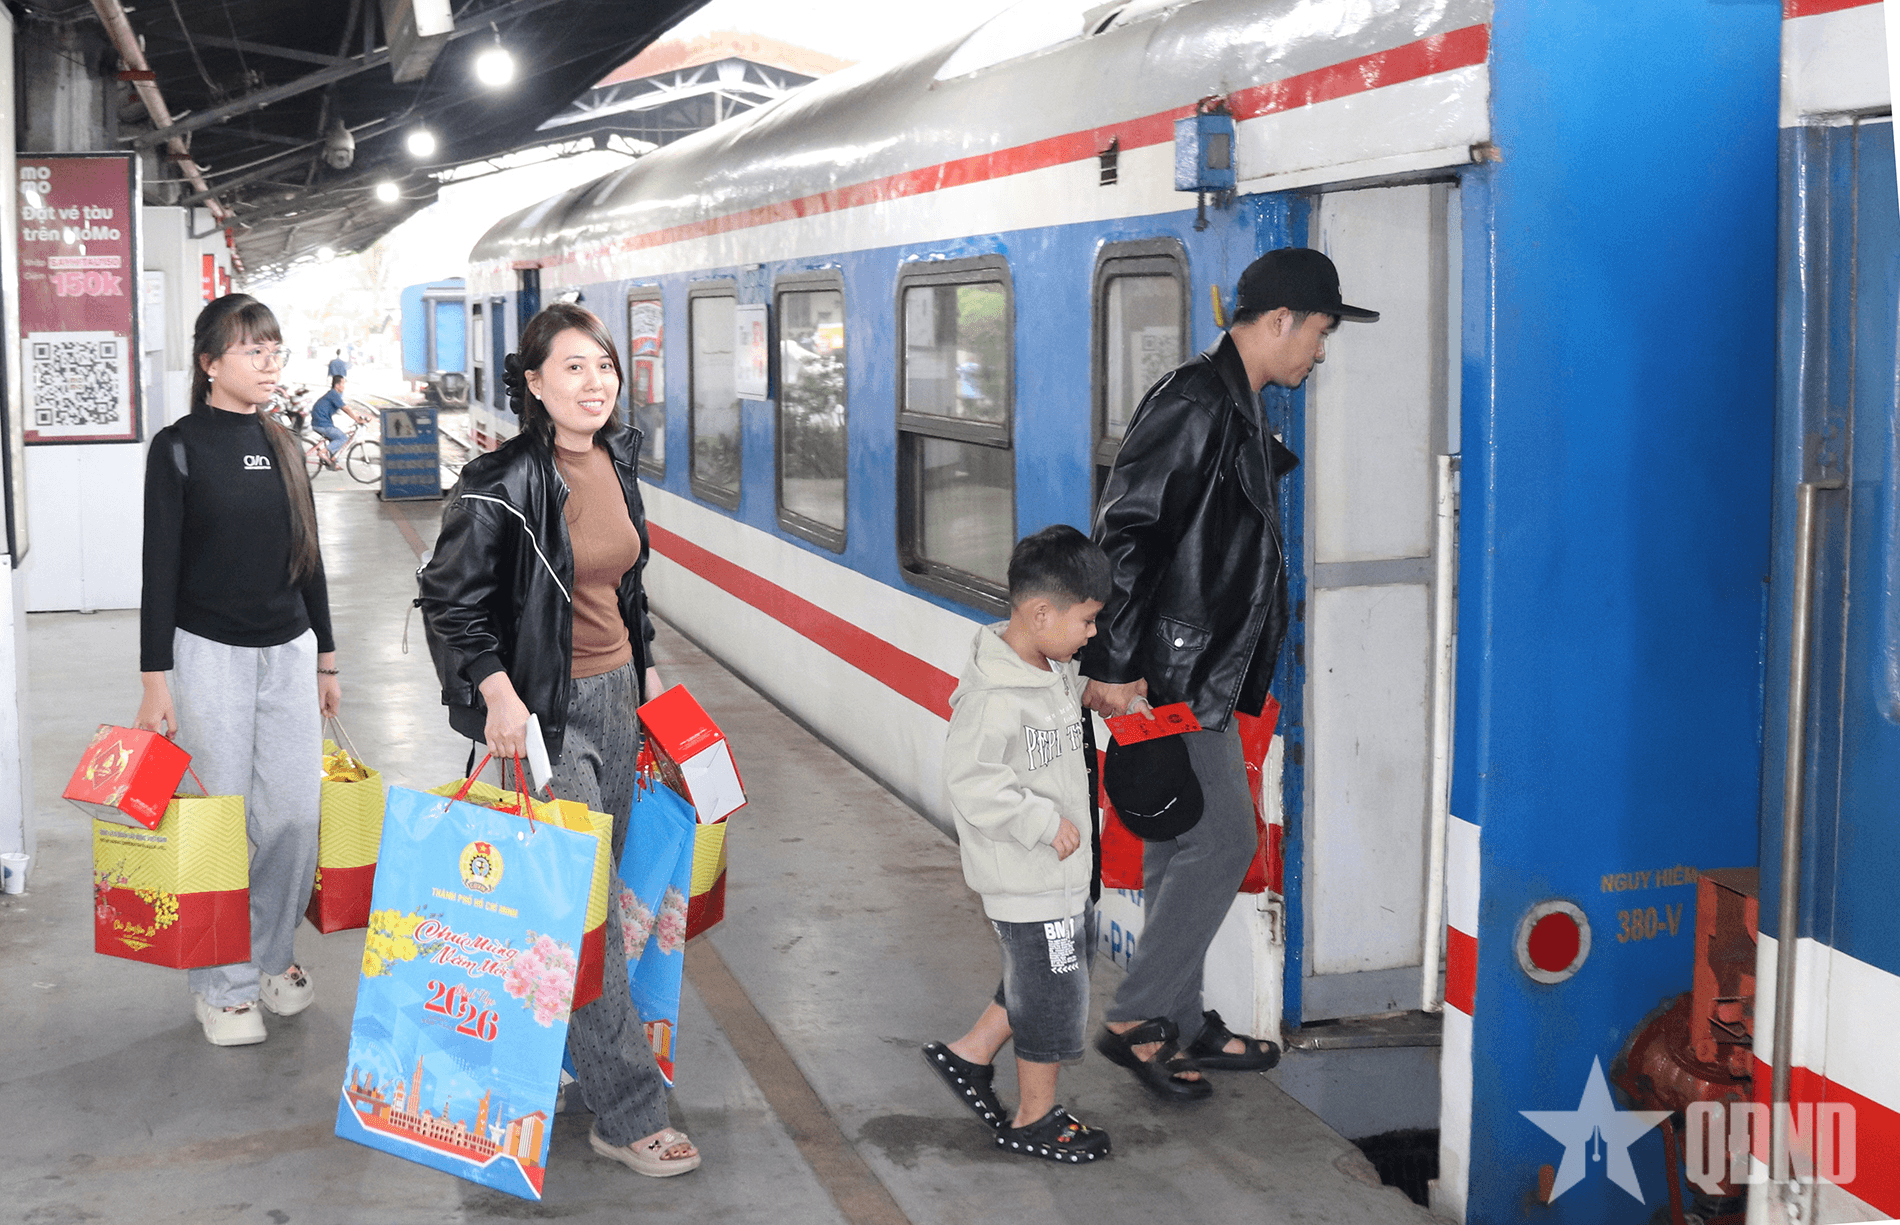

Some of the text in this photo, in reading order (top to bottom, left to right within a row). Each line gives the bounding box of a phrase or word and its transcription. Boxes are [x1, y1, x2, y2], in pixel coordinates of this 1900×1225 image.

[21, 166, 51, 180] mo
[22, 204, 114, 225] Đạt vé tàu
[22, 226, 60, 241] trên
[48, 270, 124, 297] 150k
[1600, 869, 1652, 893] NGUY
[1616, 902, 1683, 944] 380-V
